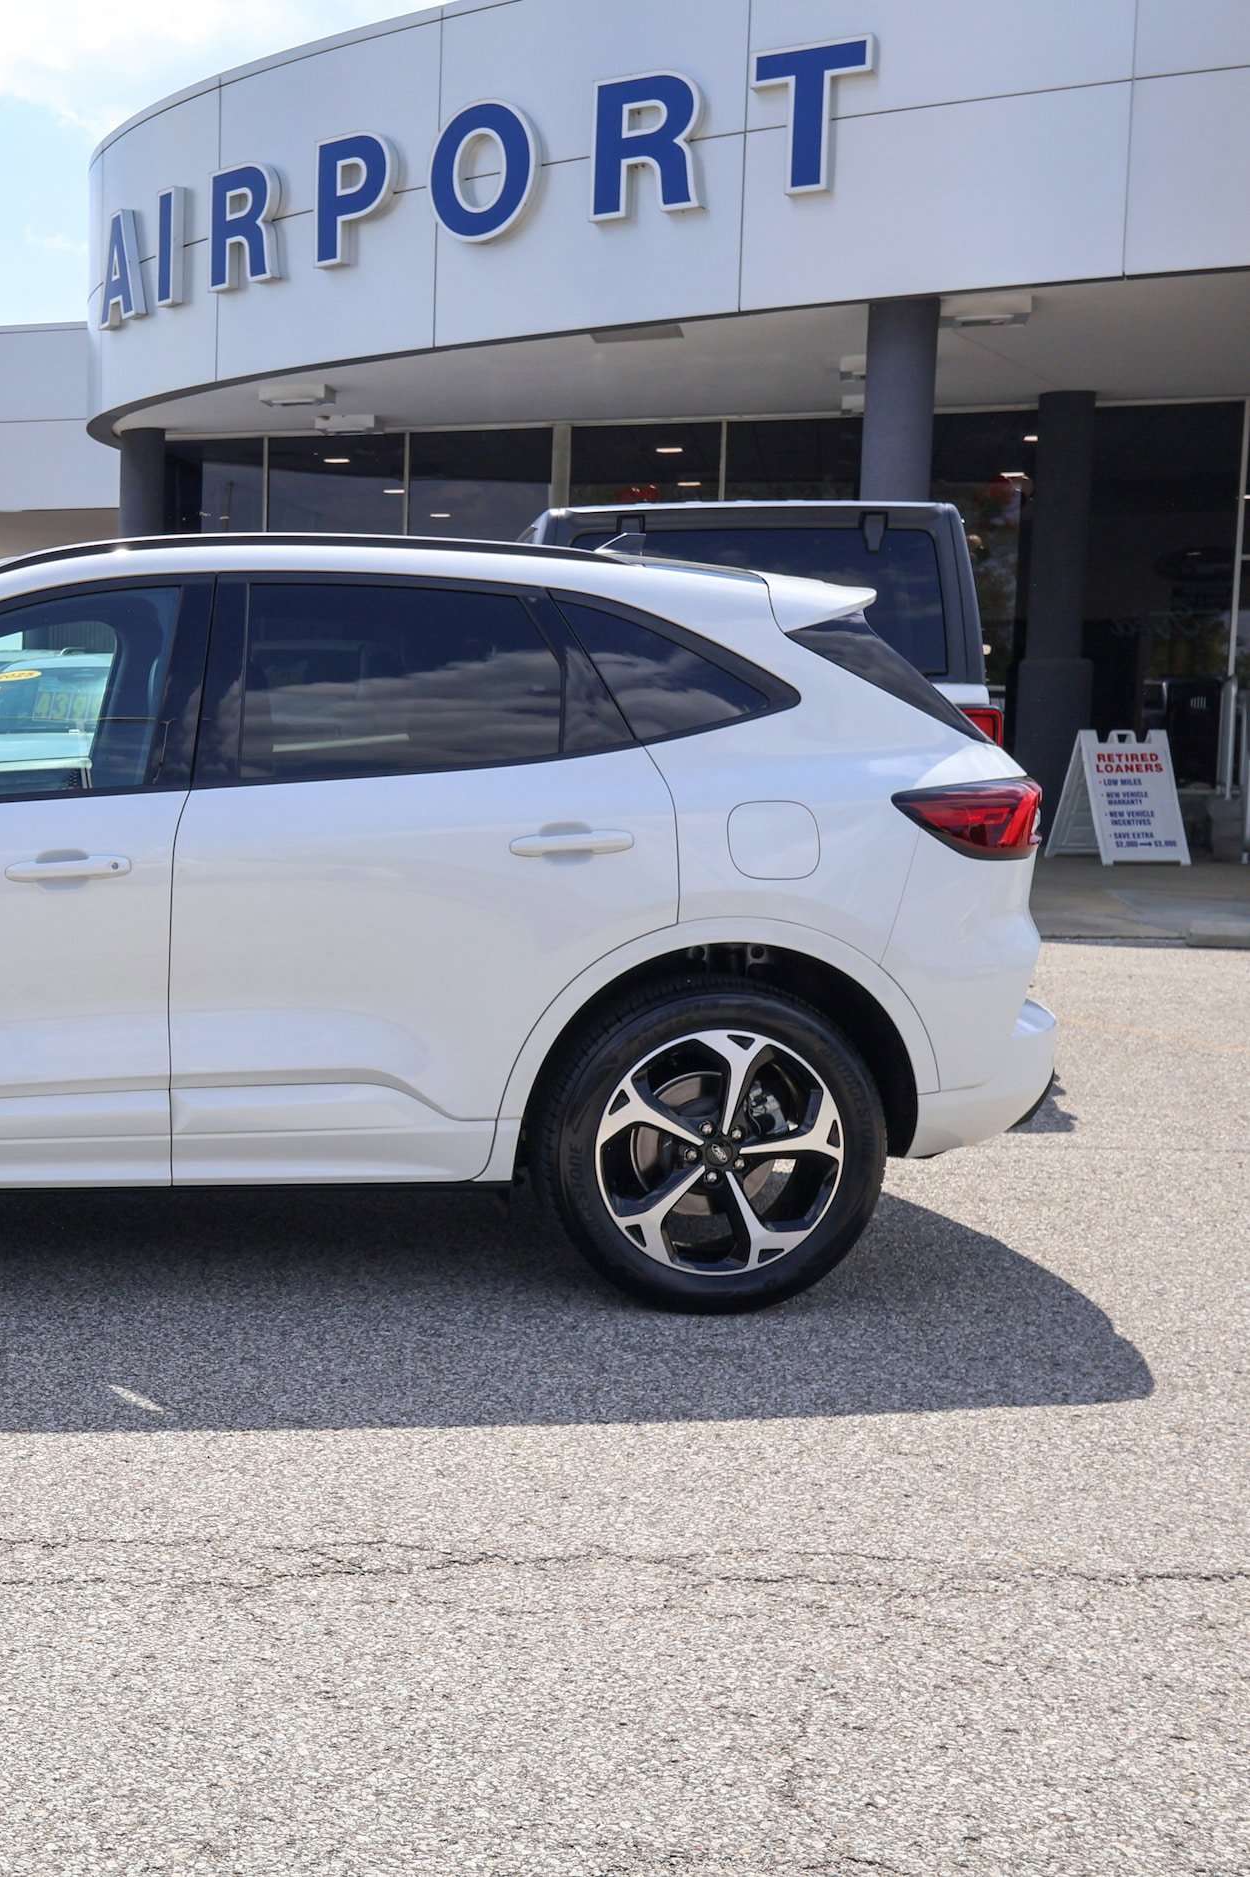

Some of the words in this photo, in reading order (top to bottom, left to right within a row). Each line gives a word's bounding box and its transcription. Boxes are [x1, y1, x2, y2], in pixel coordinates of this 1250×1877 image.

[97, 32, 875, 332] AIRPORT
[1097, 753, 1158, 763] RETIRED
[1095, 763, 1163, 773] LOANERS
[1103, 778, 1119, 786] LOW
[1120, 778, 1142, 786] MILES
[1107, 798, 1143, 806] WARRANTY
[1109, 810, 1124, 818] NEW
[1126, 810, 1155, 818] VEHICLE
[1111, 818, 1152, 826] INCENTIVES
[1113, 831, 1130, 839] SAVE
[1132, 831, 1155, 839] EXTRA
